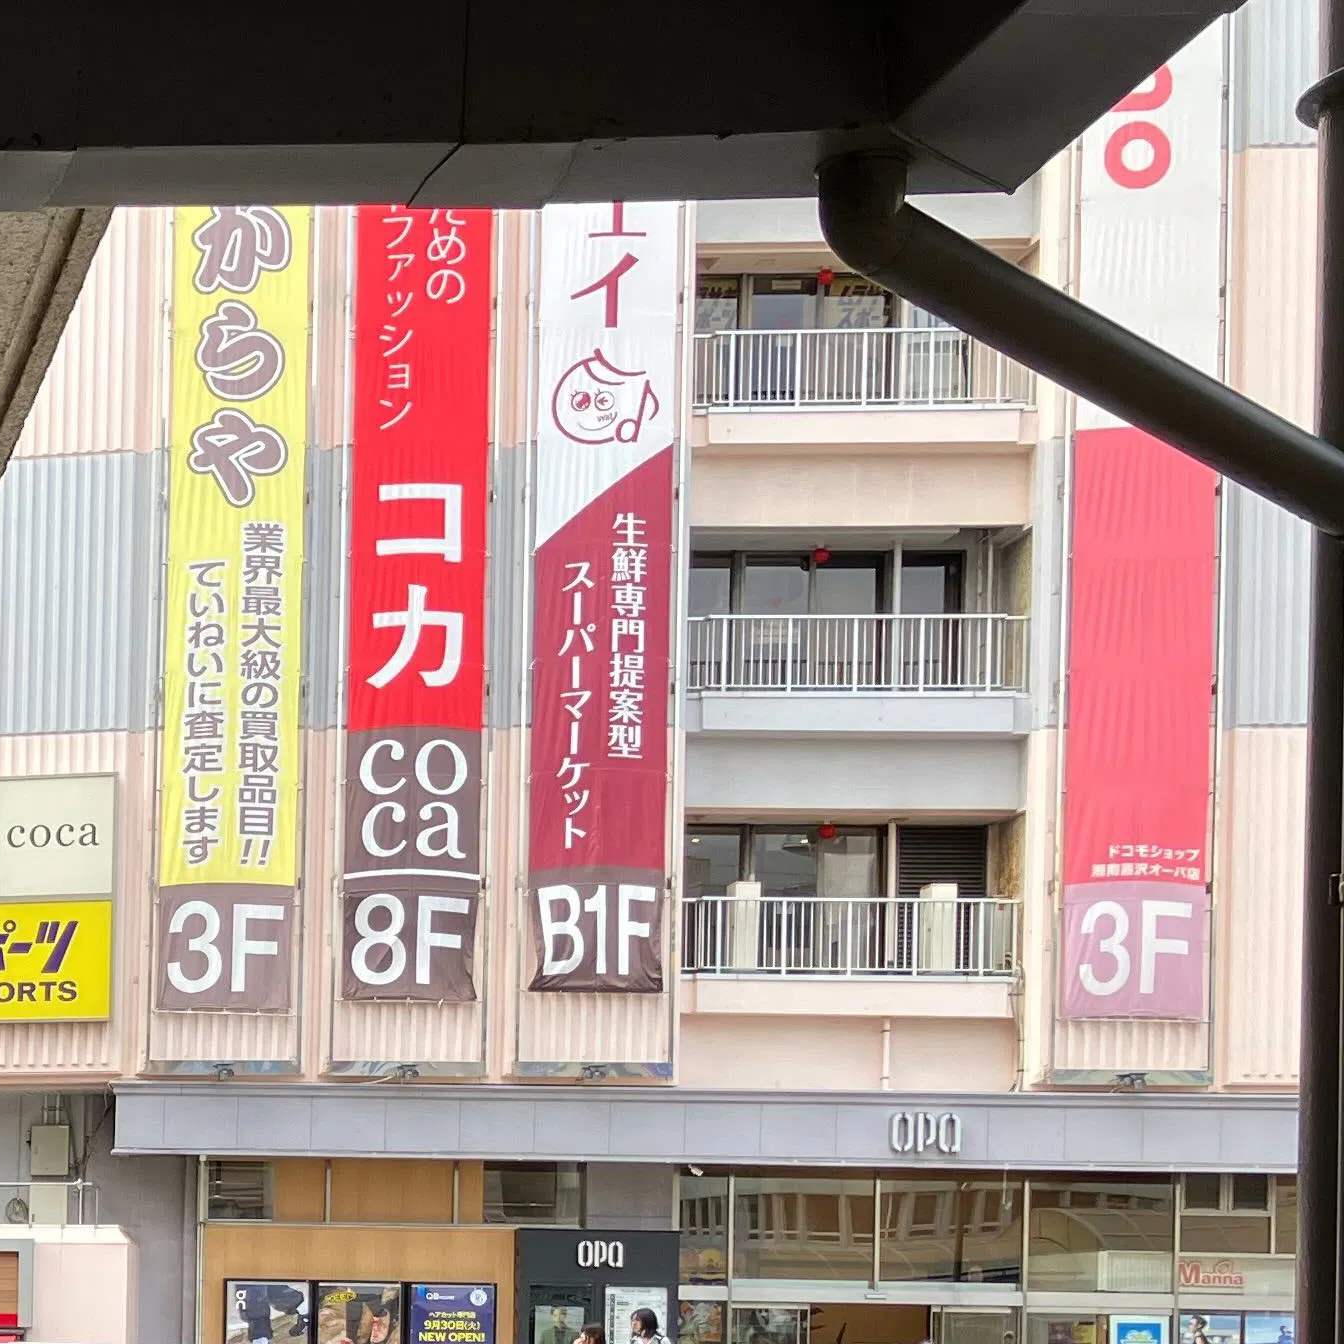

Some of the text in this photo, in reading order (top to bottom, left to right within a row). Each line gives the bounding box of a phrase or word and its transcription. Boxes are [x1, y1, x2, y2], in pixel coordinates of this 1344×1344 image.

[378, 205, 416, 431] ファッション
[367, 483, 465, 688] コカ
[609, 512, 649, 760] 生鮮専門提案型
[183, 562, 226, 865] ていねいに査定します
[555, 561, 596, 850] スーパーマーケット
[359, 738, 468, 796] co
[6, 822, 100, 850] coca
[361, 799, 466, 861] ca
[1109, 844, 1200, 862] ドコモショップ
[166, 902, 285, 995] 3F
[350, 893, 470, 986] 8F
[536, 884, 657, 977] B1F
[1078, 900, 1193, 997] 3F
[1179, 1262, 1244, 1285] Manna
[419, 1332, 486, 1343] NEW OPEN!
